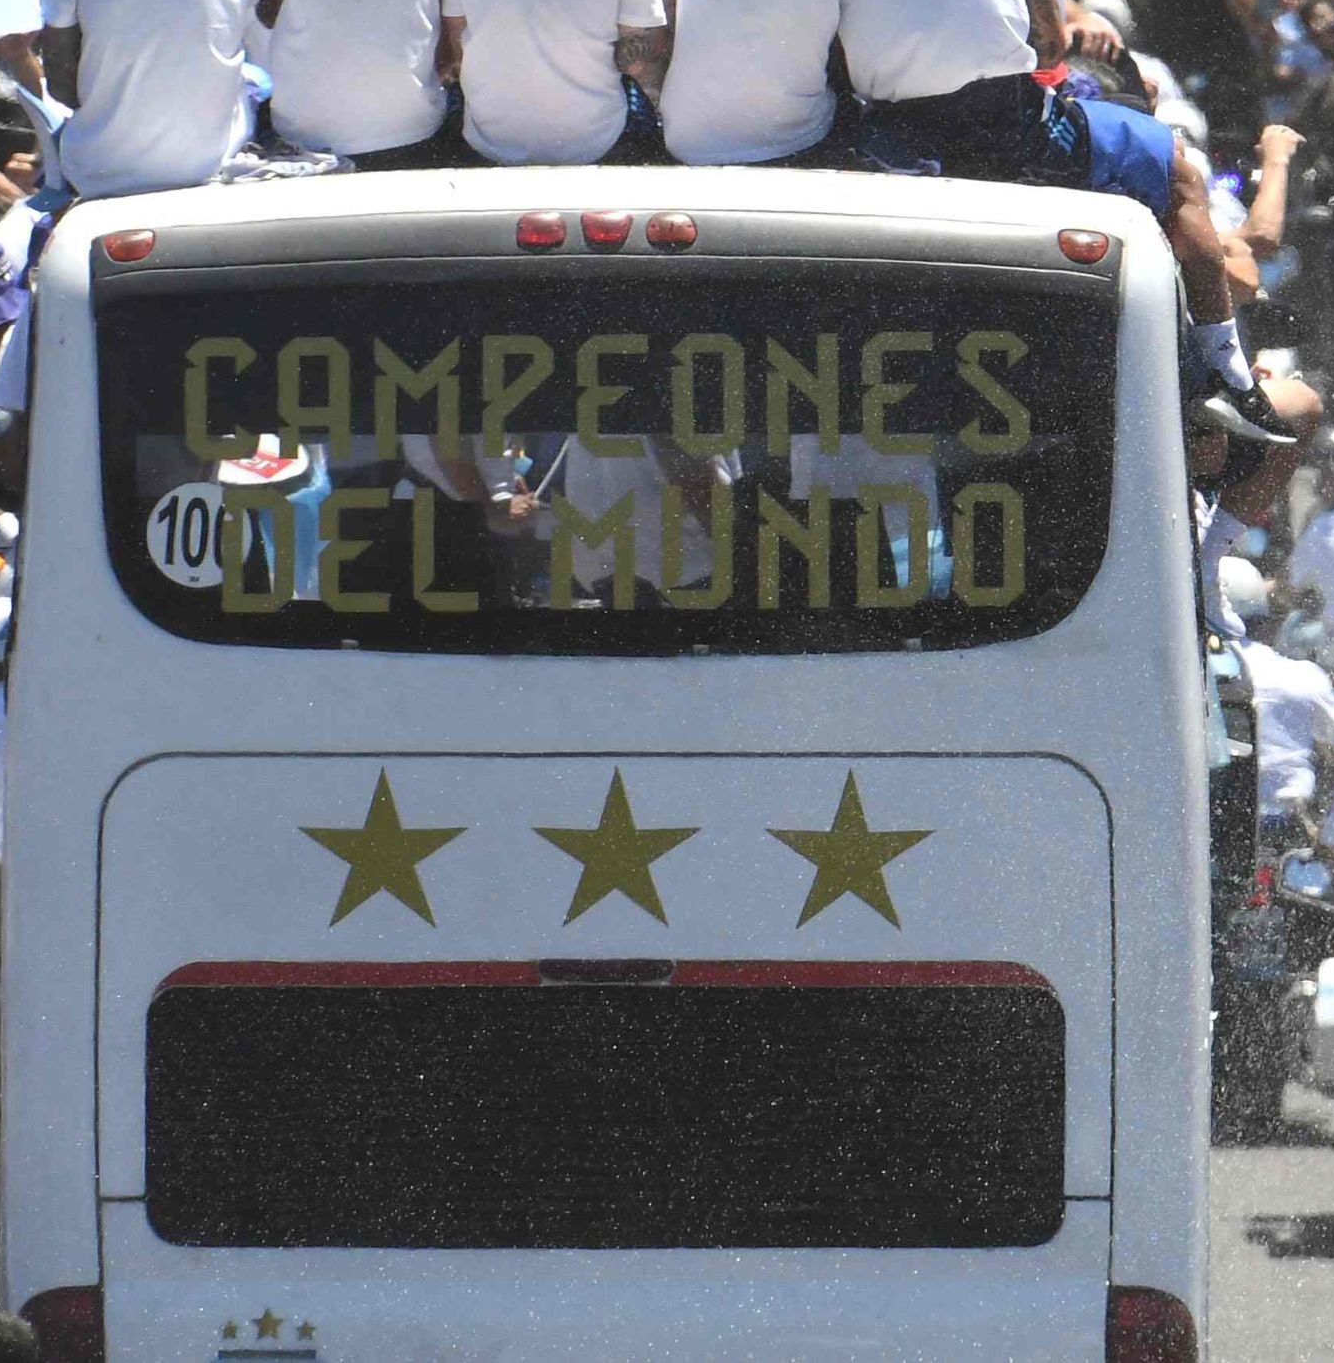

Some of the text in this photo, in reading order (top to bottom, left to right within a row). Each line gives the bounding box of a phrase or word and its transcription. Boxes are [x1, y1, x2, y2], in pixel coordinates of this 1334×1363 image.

[185, 331, 1029, 460] CAMPEONES
[221, 482, 1025, 613] DEL MUNDO
